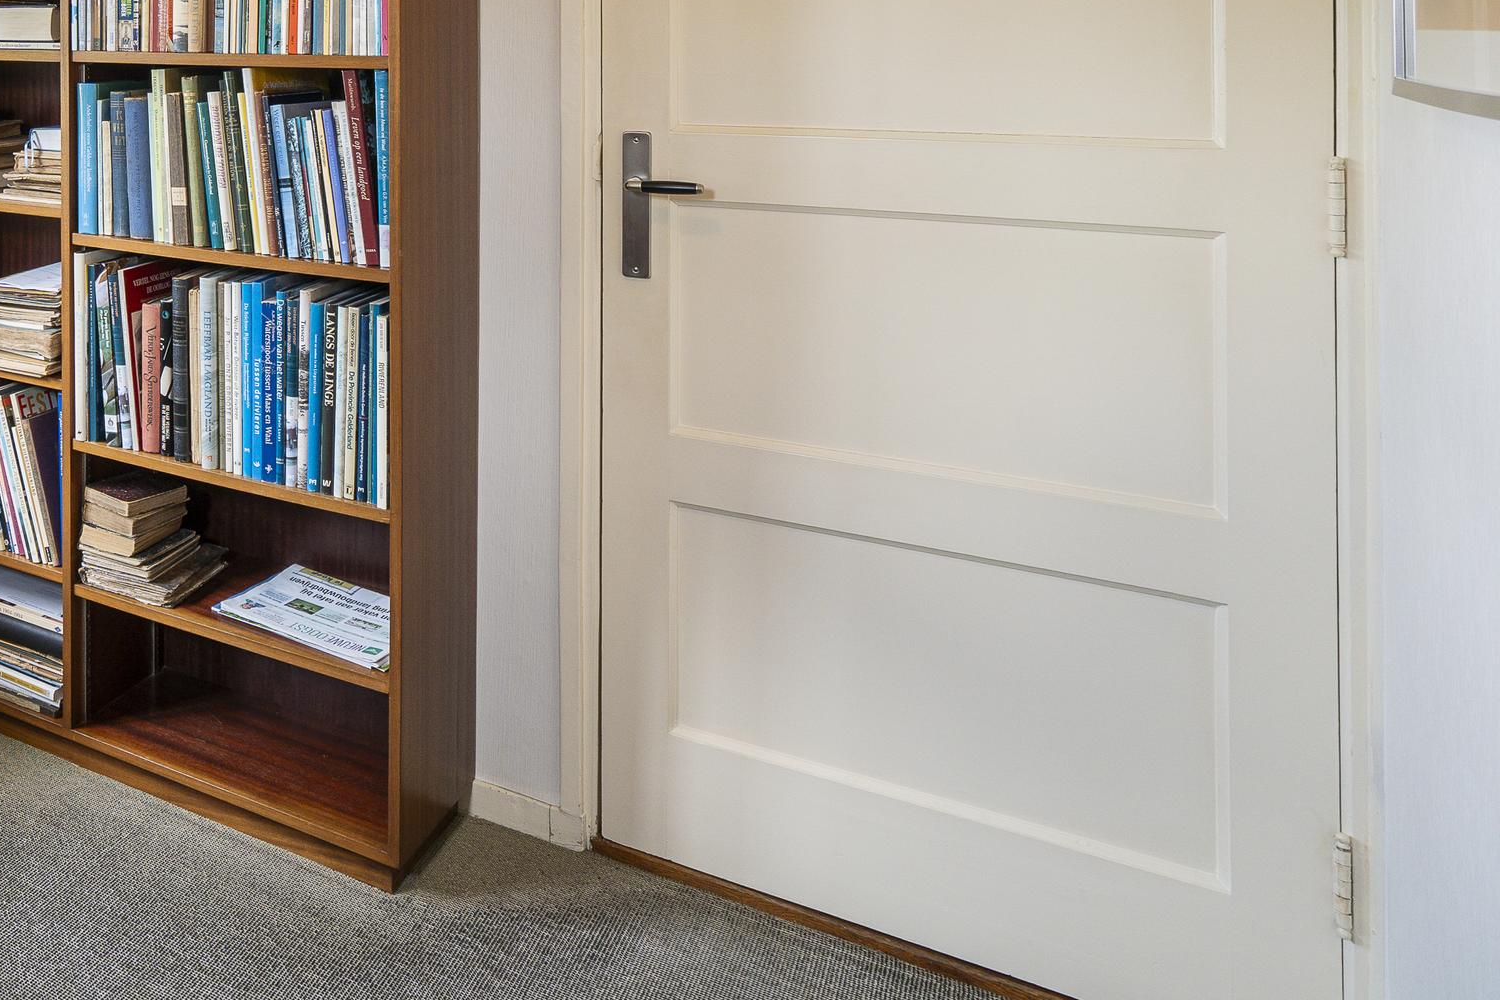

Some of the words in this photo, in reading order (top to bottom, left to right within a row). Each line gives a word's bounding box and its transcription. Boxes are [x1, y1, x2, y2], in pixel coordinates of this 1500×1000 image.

[350, 116, 360, 139] Leven
[352, 140, 362, 150] op
[355, 152, 364, 165] een
[357, 166, 370, 201] landgoed
[276, 299, 284, 311] De
[203, 310, 212, 361] LEEFBAAR
[326, 312, 336, 350] LANGS
[264, 320, 273, 365] Watersnood
[276, 360, 284, 376] het
[325, 353, 334, 368] DE
[264, 366, 272, 391] tussen
[348, 371, 355, 381] De
[204, 364, 212, 418] LAAGLAND
[254, 389, 261, 400] de
[324, 371, 334, 406] LINGE
[347, 382, 355, 412] Provincie
[265, 414, 271, 424] en
[265, 426, 273, 445] Waal
[346, 414, 354, 450] Gelderland
[300, 588, 312, 597] bij
[313, 593, 334, 605] tafel
[335, 600, 353, 611] aan
[354, 604, 379, 618] vaker
